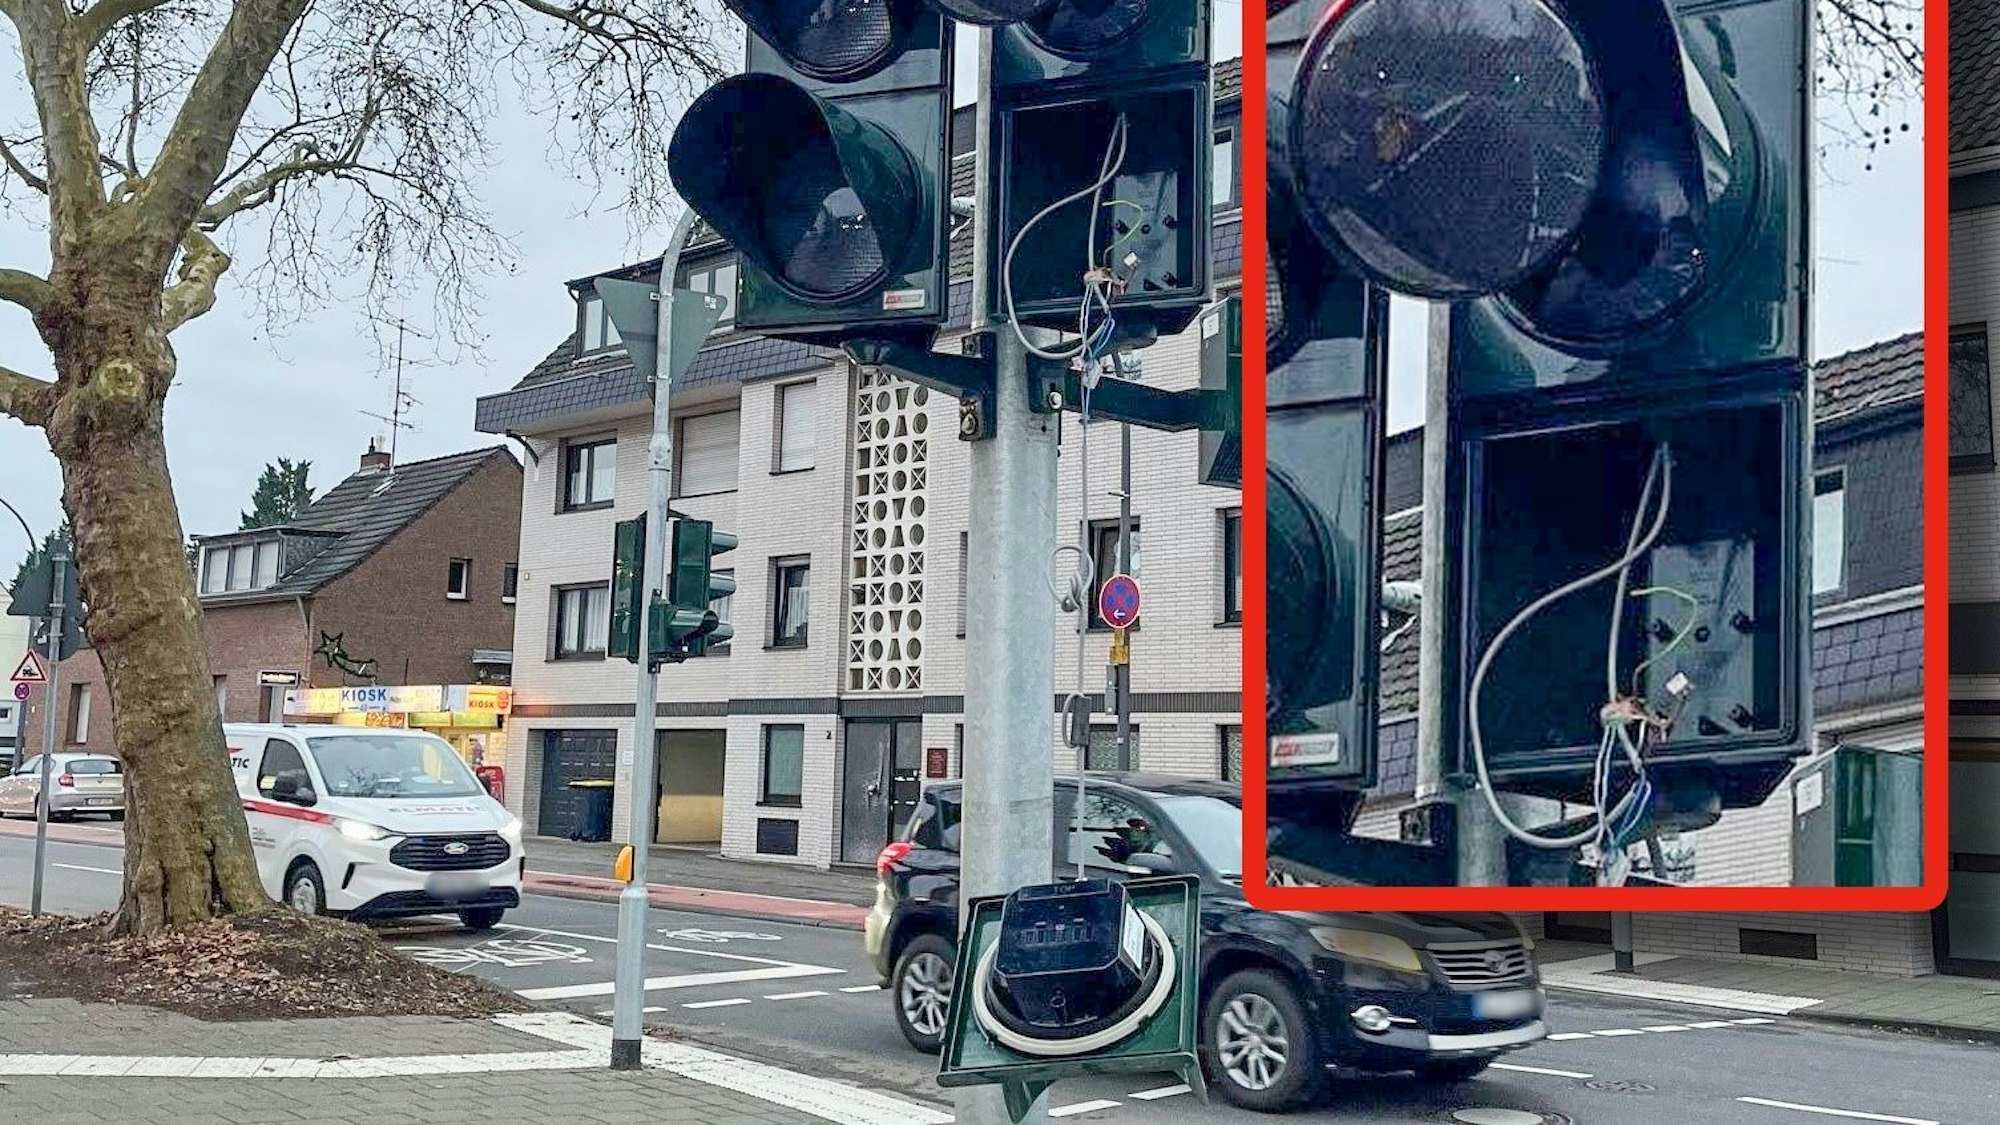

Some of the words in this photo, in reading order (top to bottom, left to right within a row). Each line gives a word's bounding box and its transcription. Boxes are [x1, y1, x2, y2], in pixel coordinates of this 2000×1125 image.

[341, 688, 387, 701] KIOSK
[826, 730, 832, 740] 2
[232, 757, 249, 768] TIC
